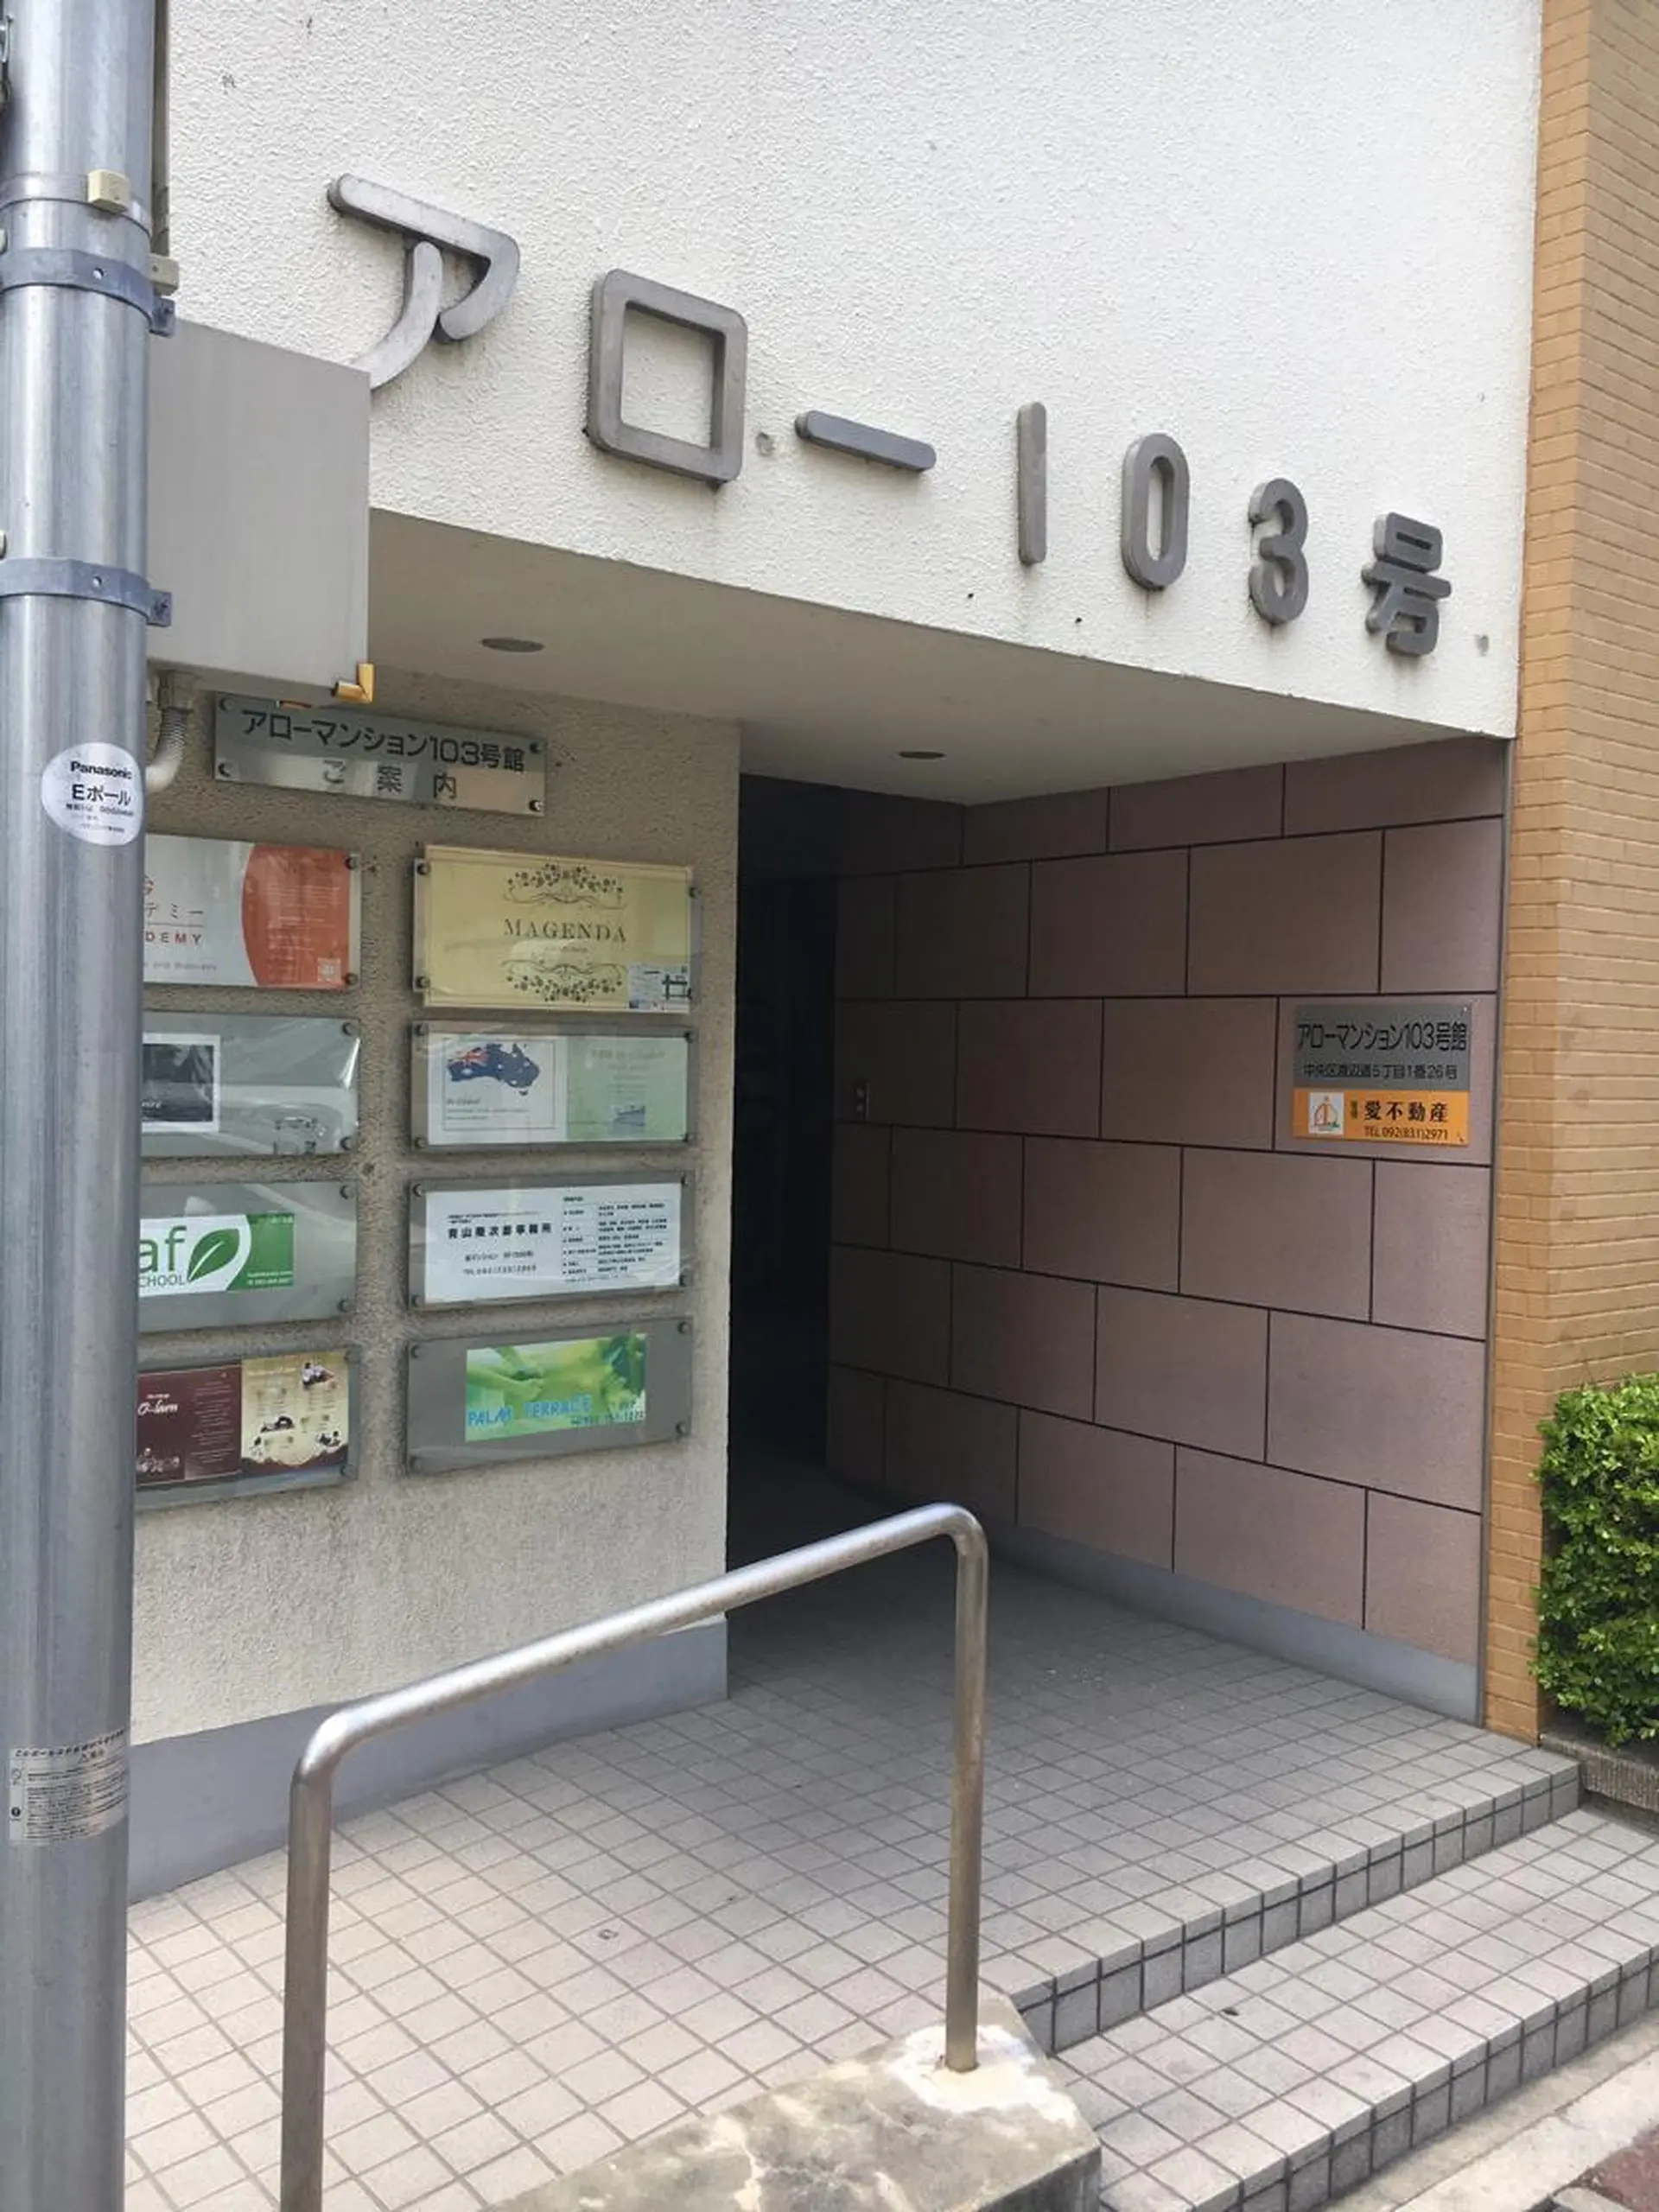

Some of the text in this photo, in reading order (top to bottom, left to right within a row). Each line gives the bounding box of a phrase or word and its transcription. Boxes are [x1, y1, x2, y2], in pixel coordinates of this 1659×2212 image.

[242, 709, 524, 772] アローマンション103号館
[70, 760, 132, 779] Panasonic
[72, 783, 131, 805] Eポール
[504, 918, 627, 944] MAGENDA
[1298, 1021, 1468, 1052] アローマンション103号館
[1363, 1100, 1449, 1123] 愛不動産
